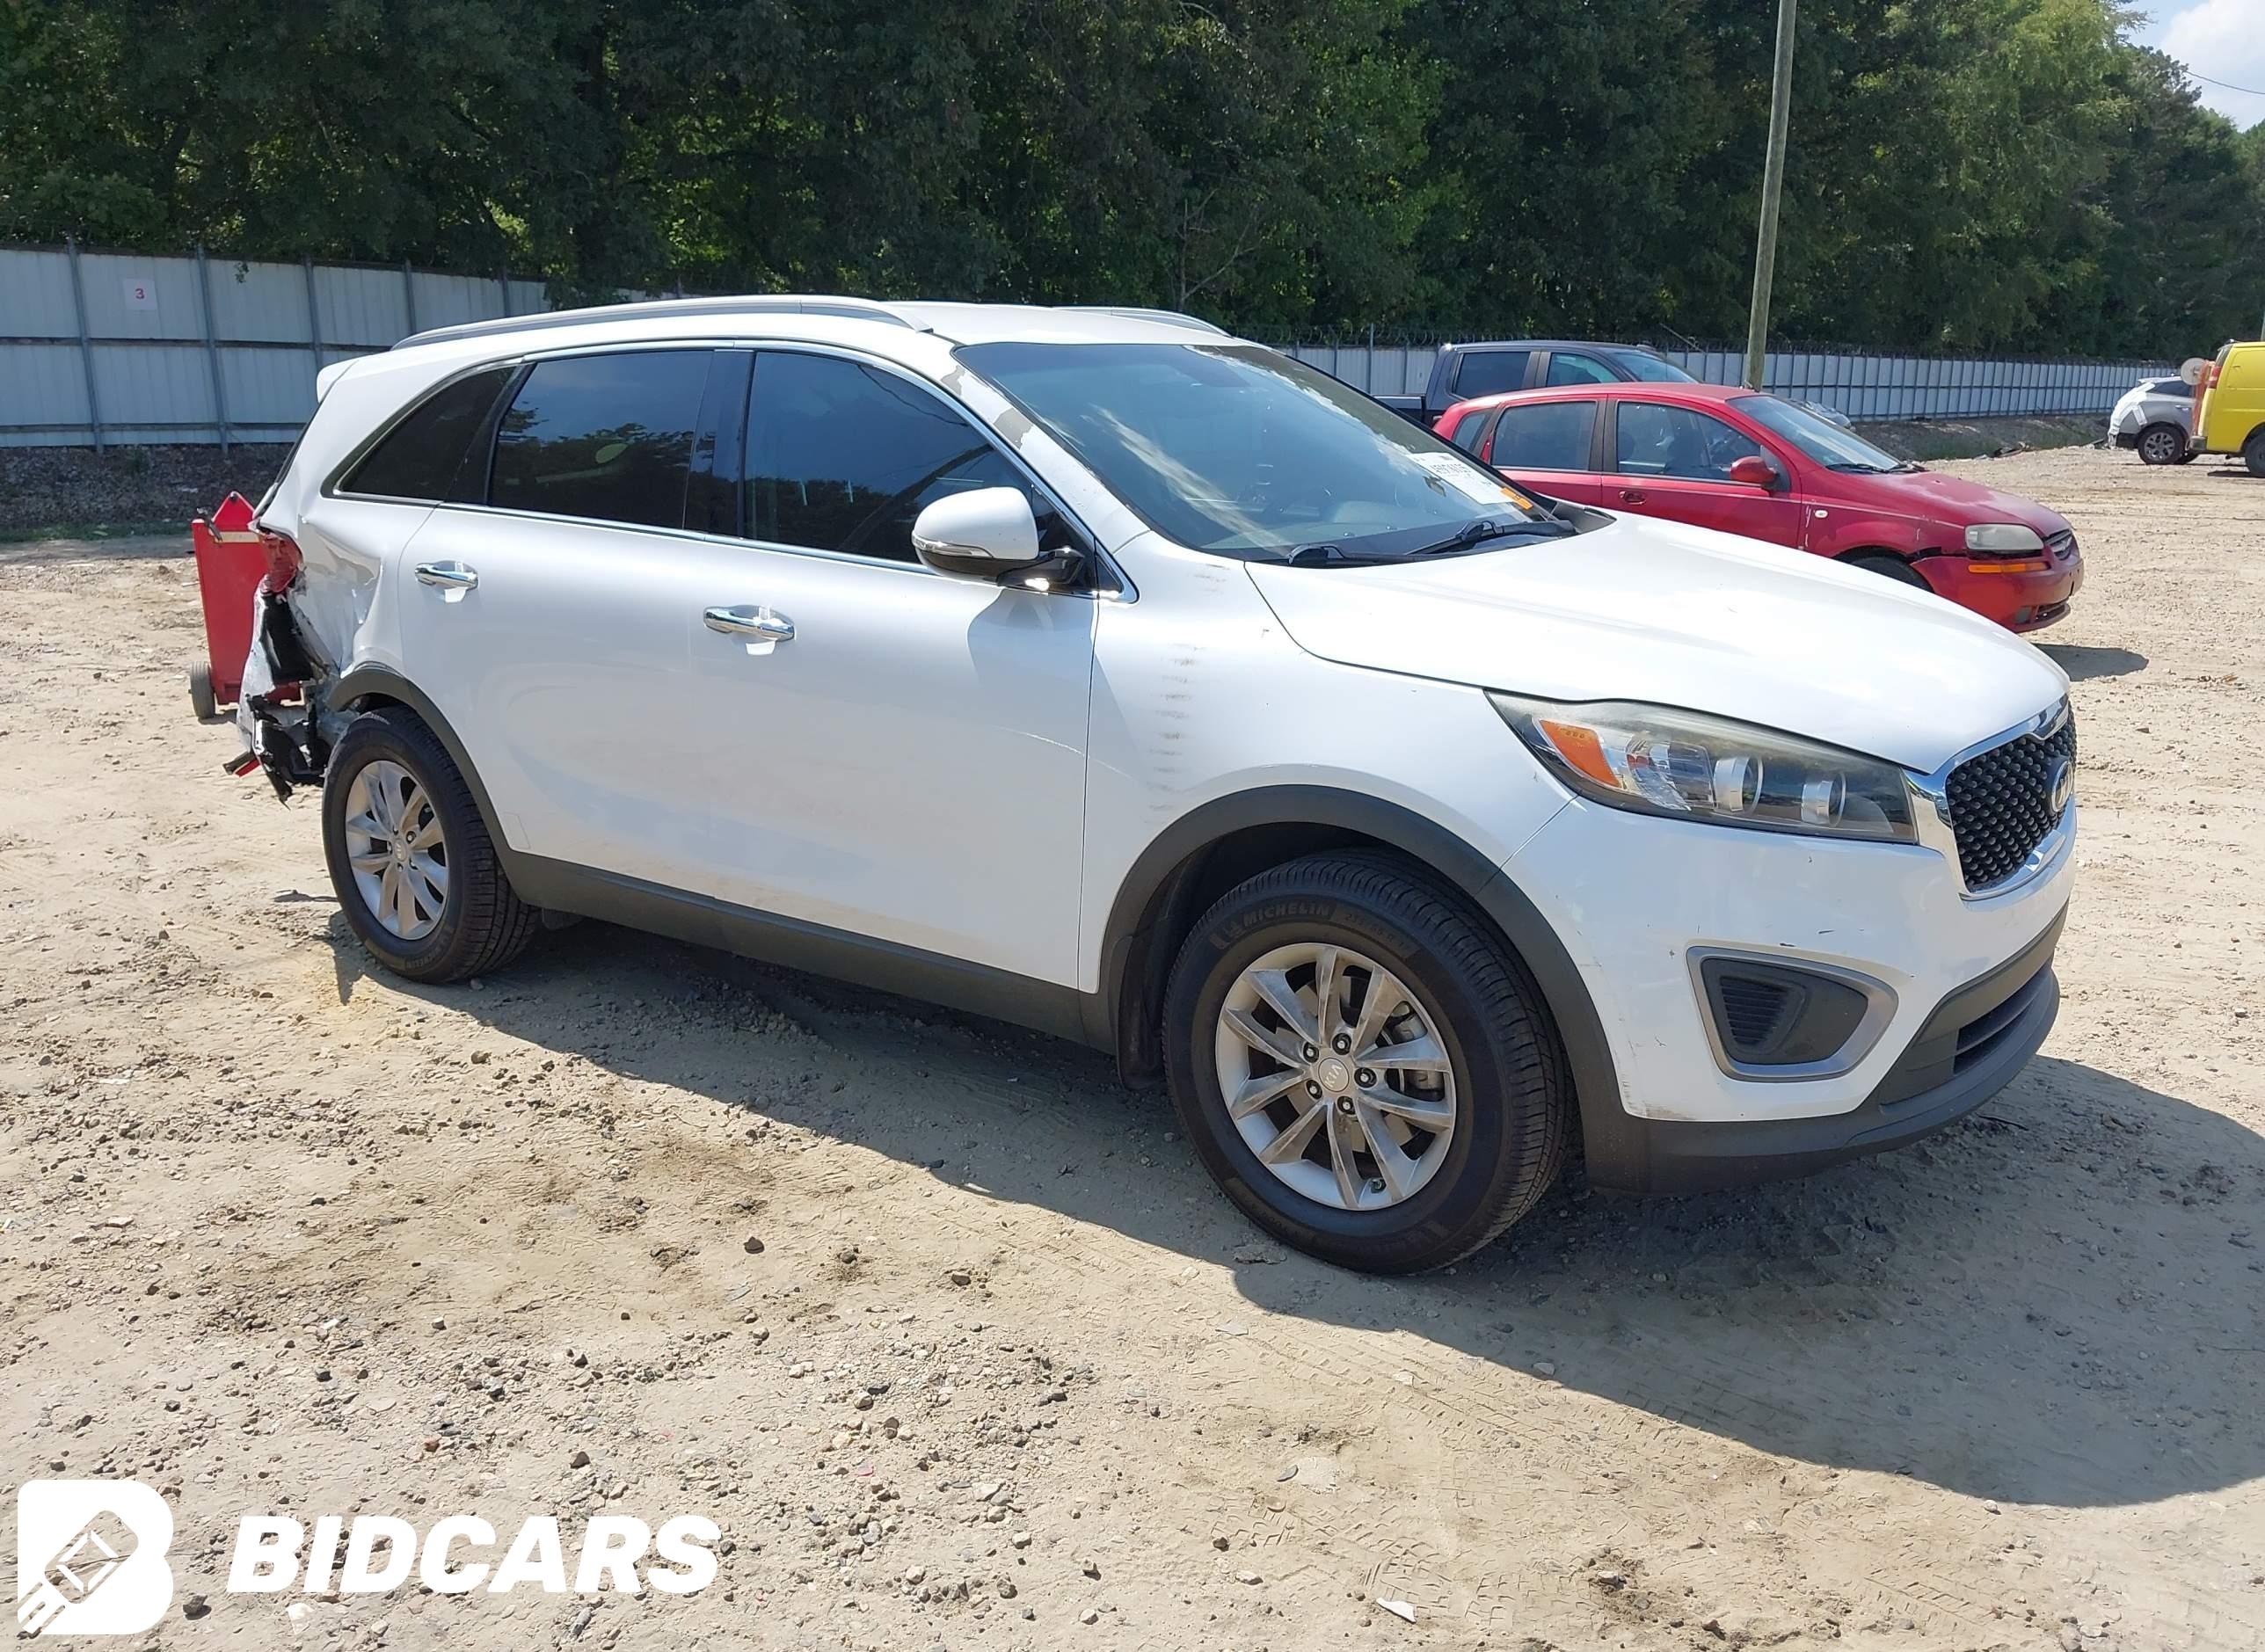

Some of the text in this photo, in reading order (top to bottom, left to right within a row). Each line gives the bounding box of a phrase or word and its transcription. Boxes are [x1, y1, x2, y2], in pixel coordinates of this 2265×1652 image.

[135, 287, 145, 300] 3
[1242, 902, 1330, 928] MICHELIN
[1324, 1065, 1342, 1088] KIA
